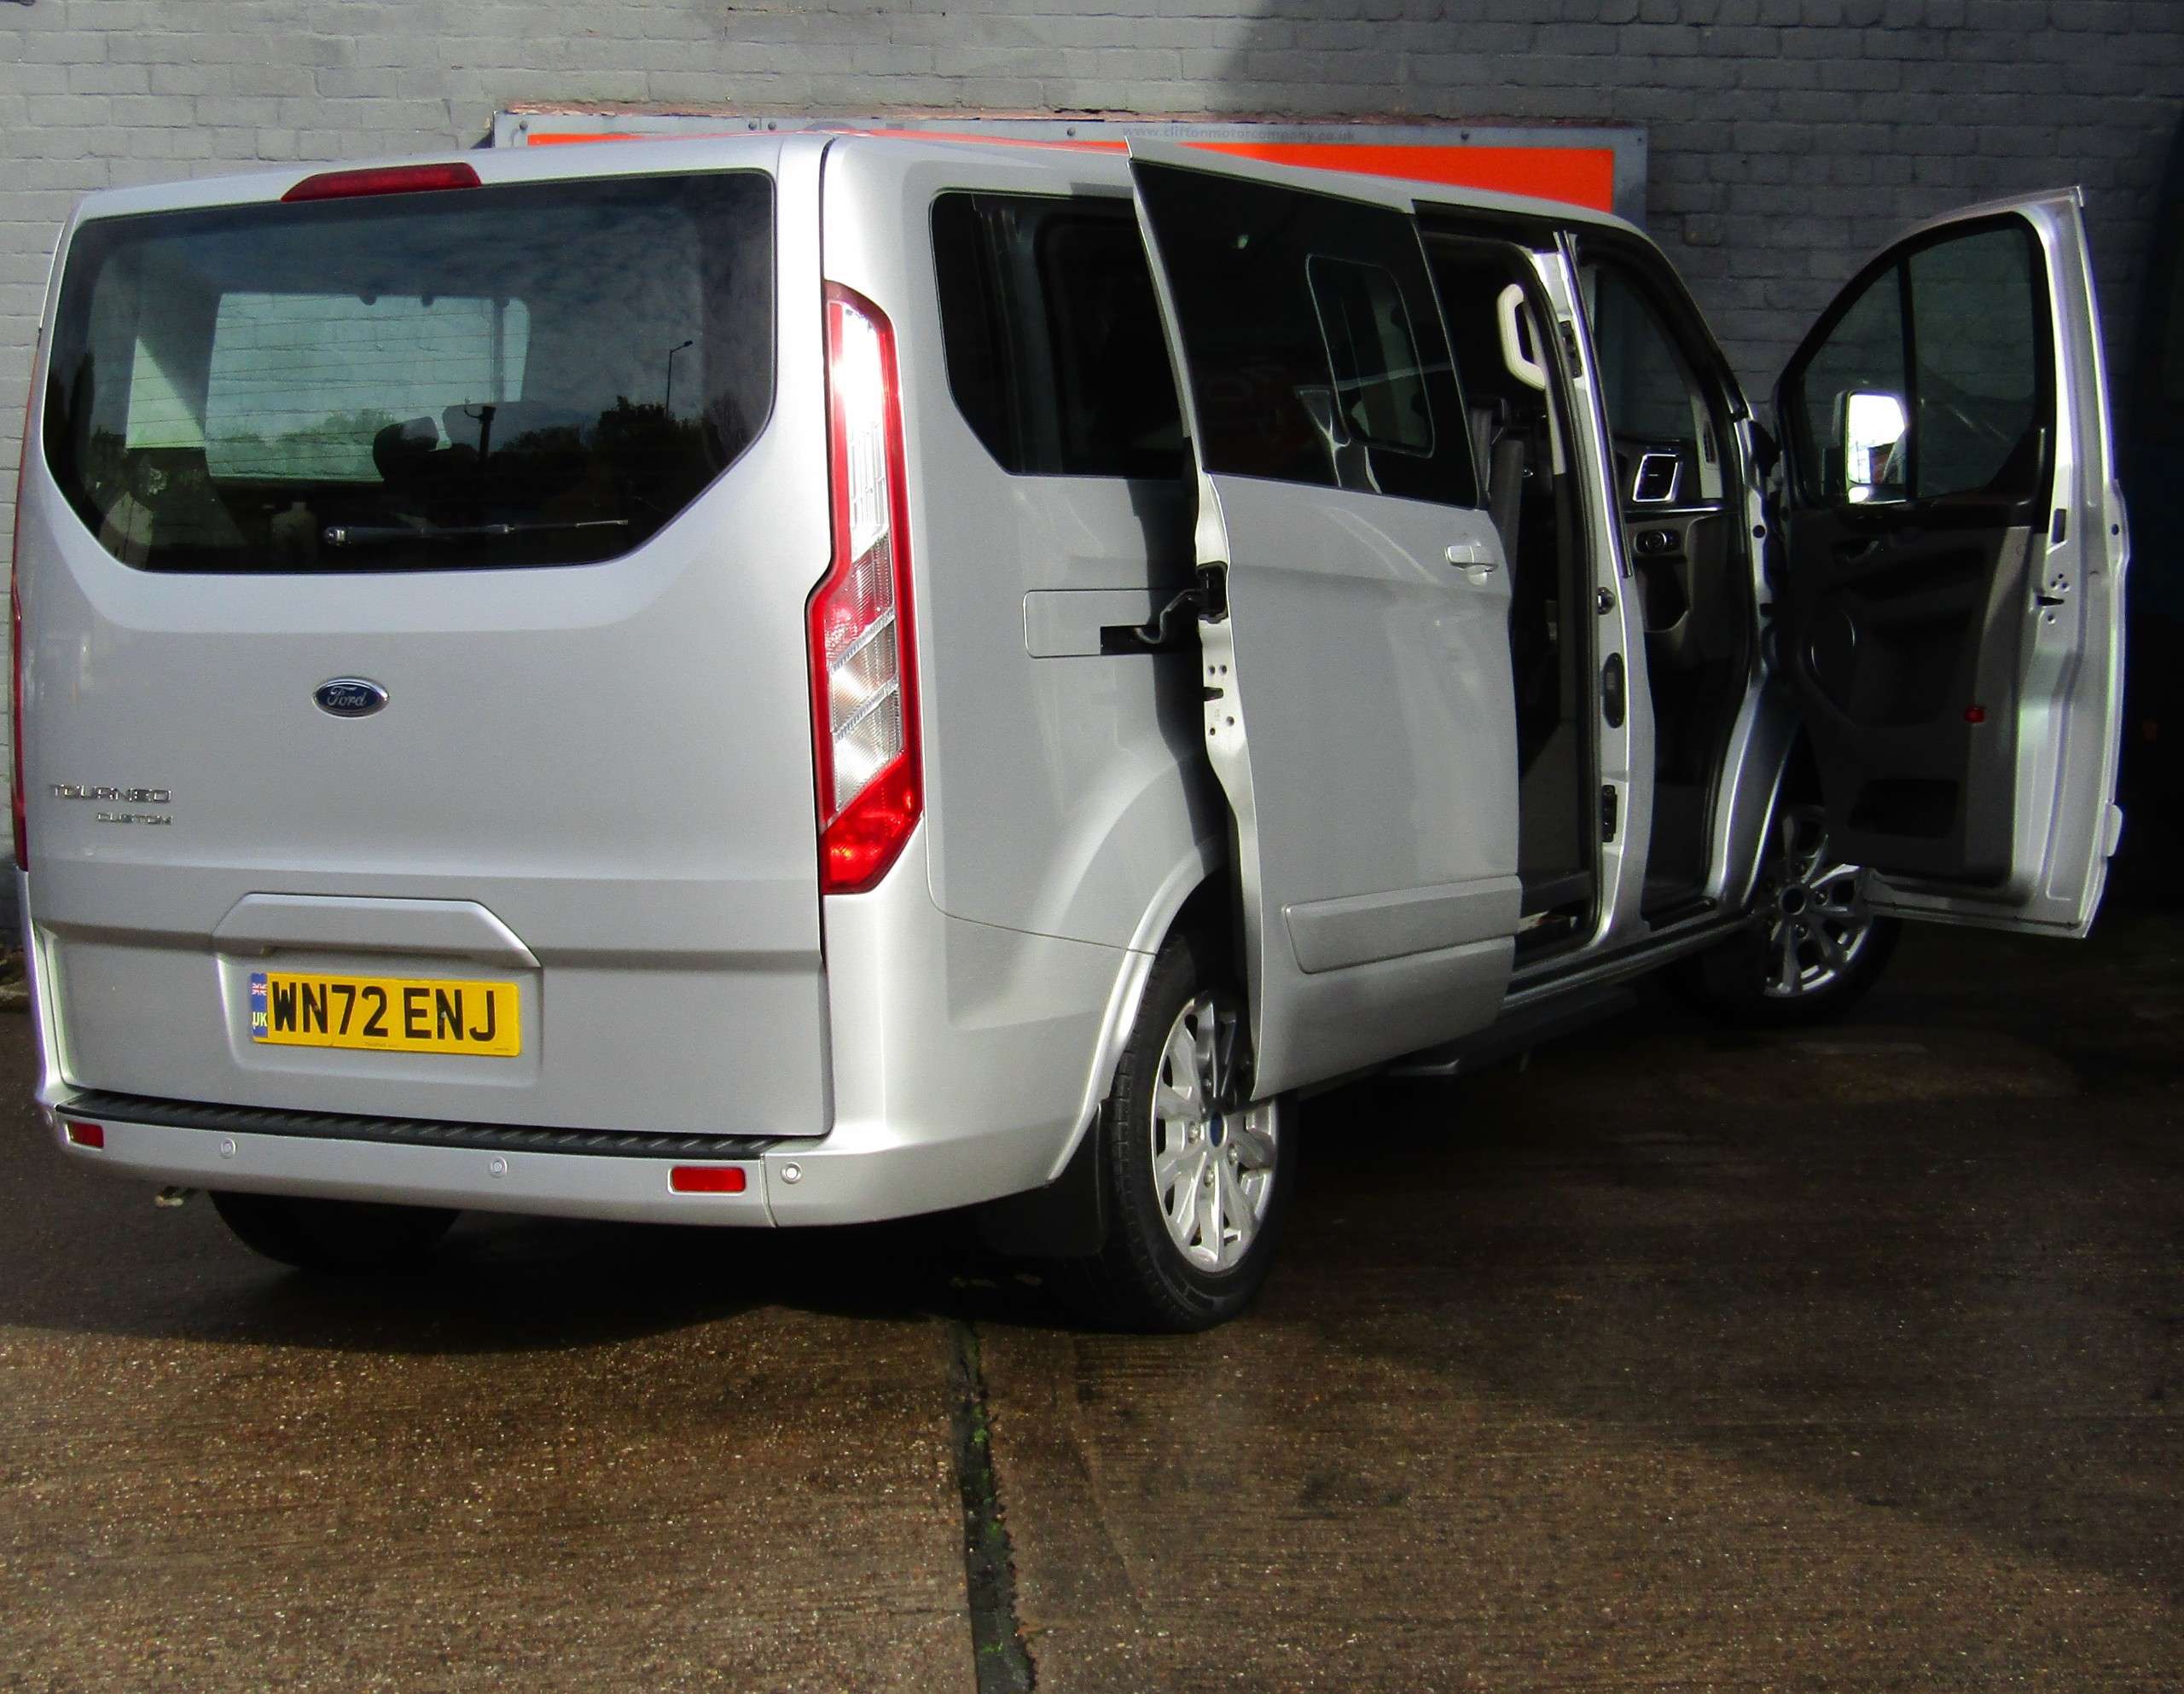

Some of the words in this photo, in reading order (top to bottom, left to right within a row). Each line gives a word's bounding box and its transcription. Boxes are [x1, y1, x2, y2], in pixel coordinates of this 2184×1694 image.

[327, 686, 368, 706] Ford
[49, 784, 171, 803] TOURNEO
[253, 1012, 268, 1029] UK
[272, 981, 389, 1038] WN72
[403, 987, 497, 1042] ENJ
